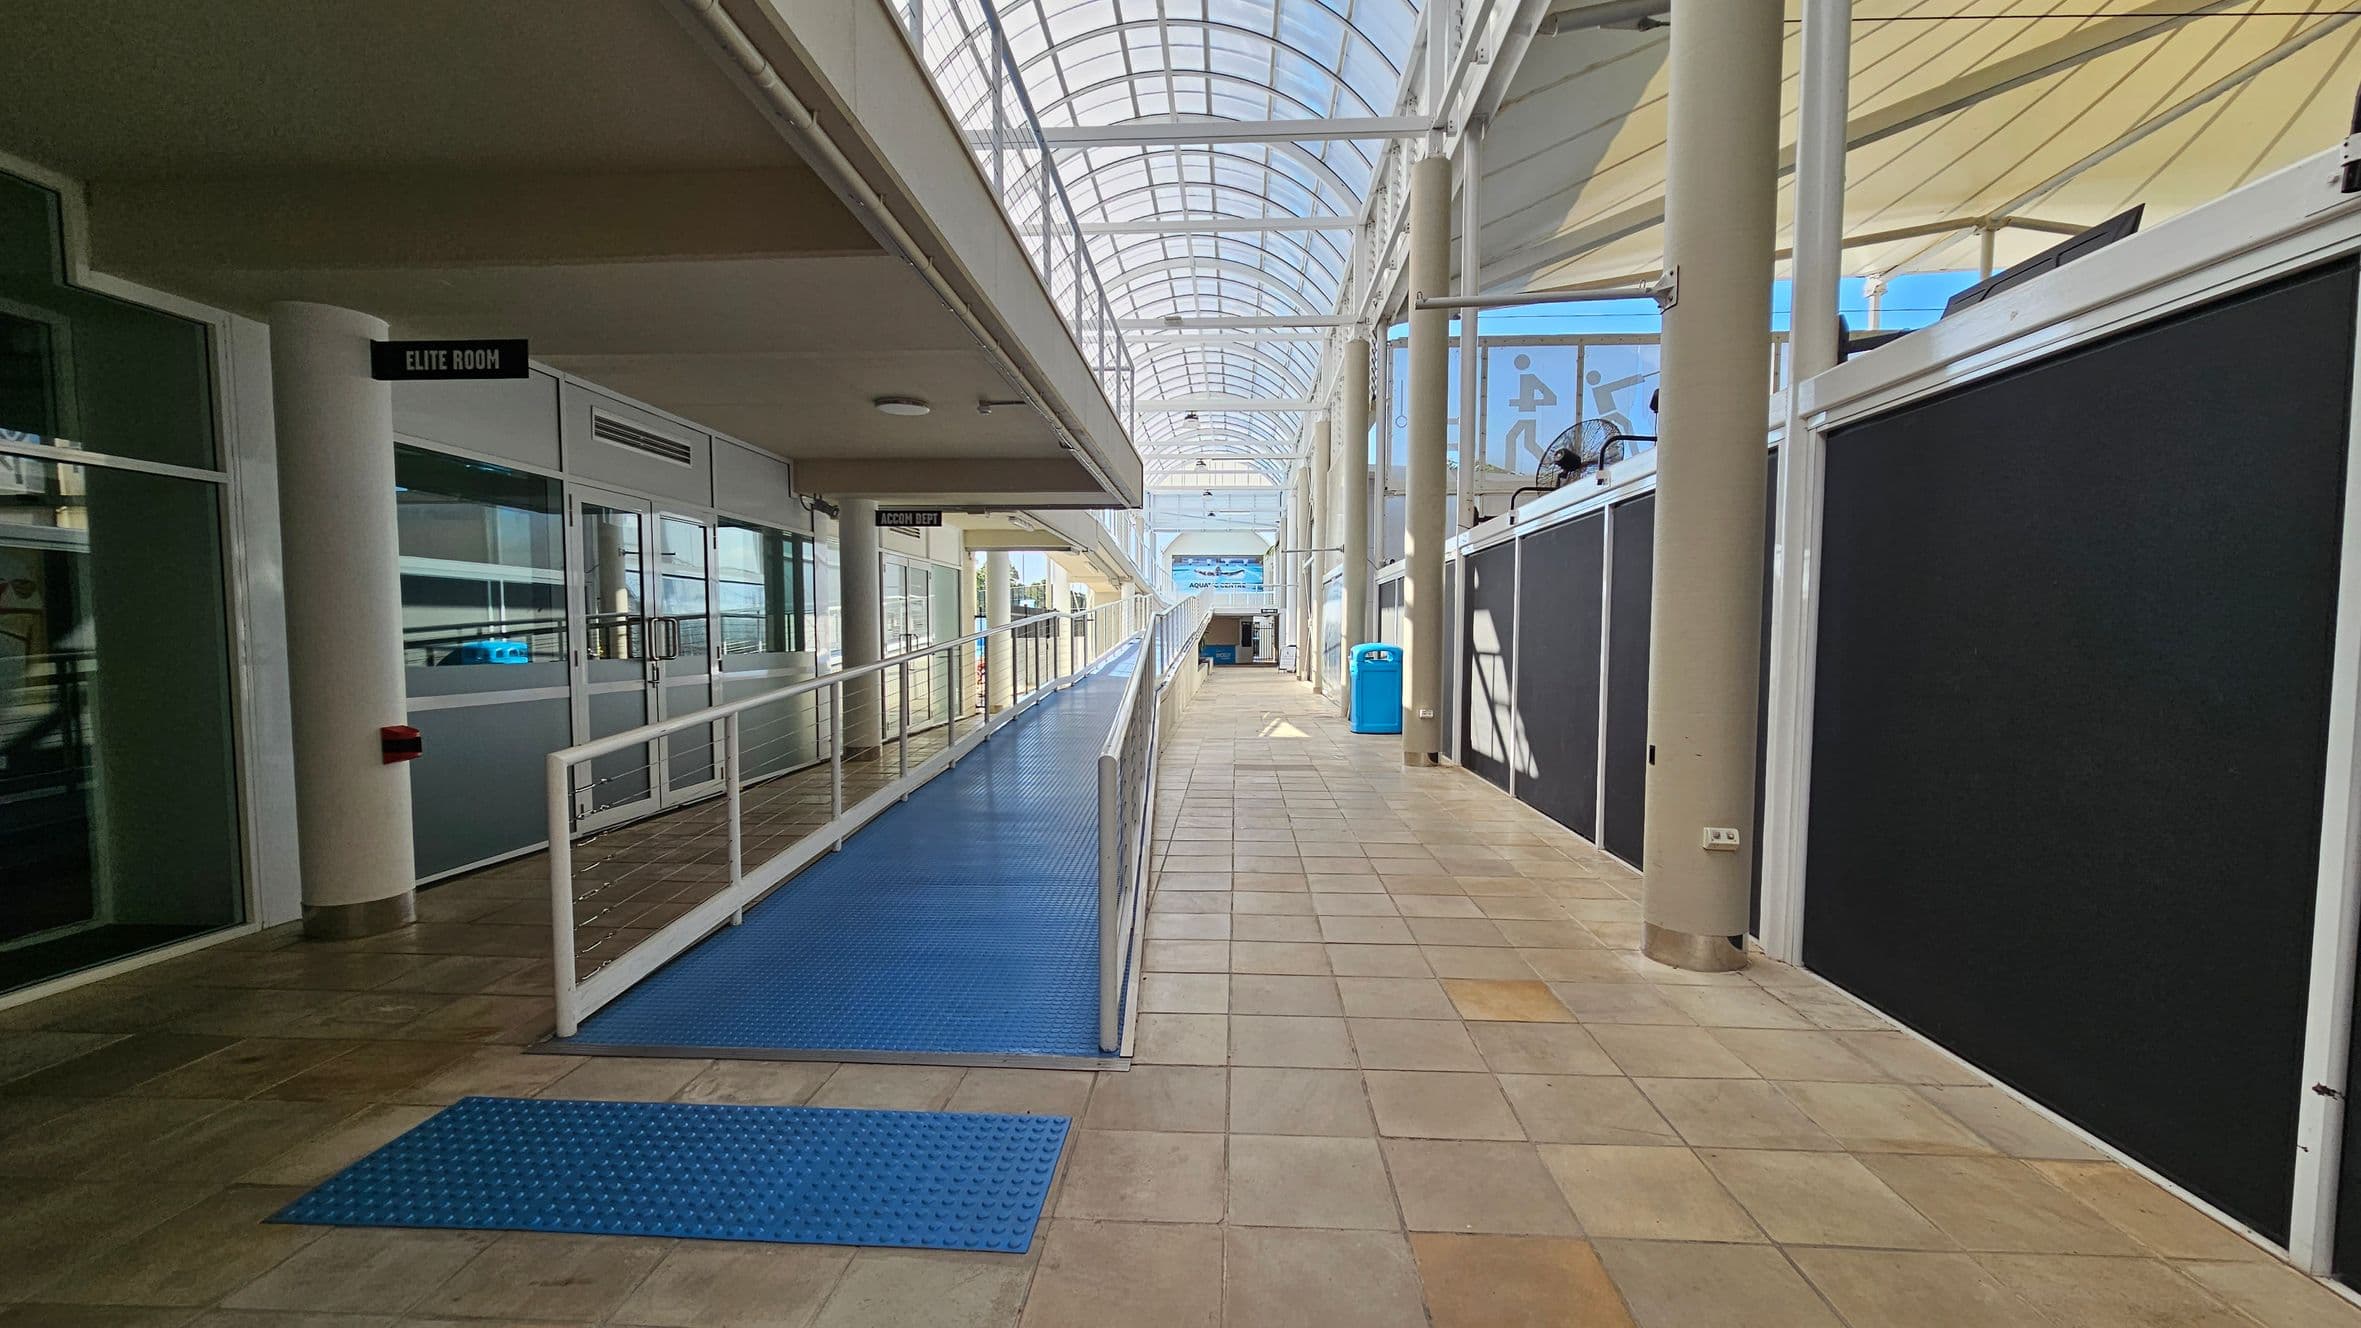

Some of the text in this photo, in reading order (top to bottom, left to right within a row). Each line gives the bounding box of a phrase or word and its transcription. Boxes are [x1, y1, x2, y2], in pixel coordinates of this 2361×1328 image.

[405, 349, 500, 371] ELITE ROOM
[881, 512, 939, 525] ACCOM DEPT
